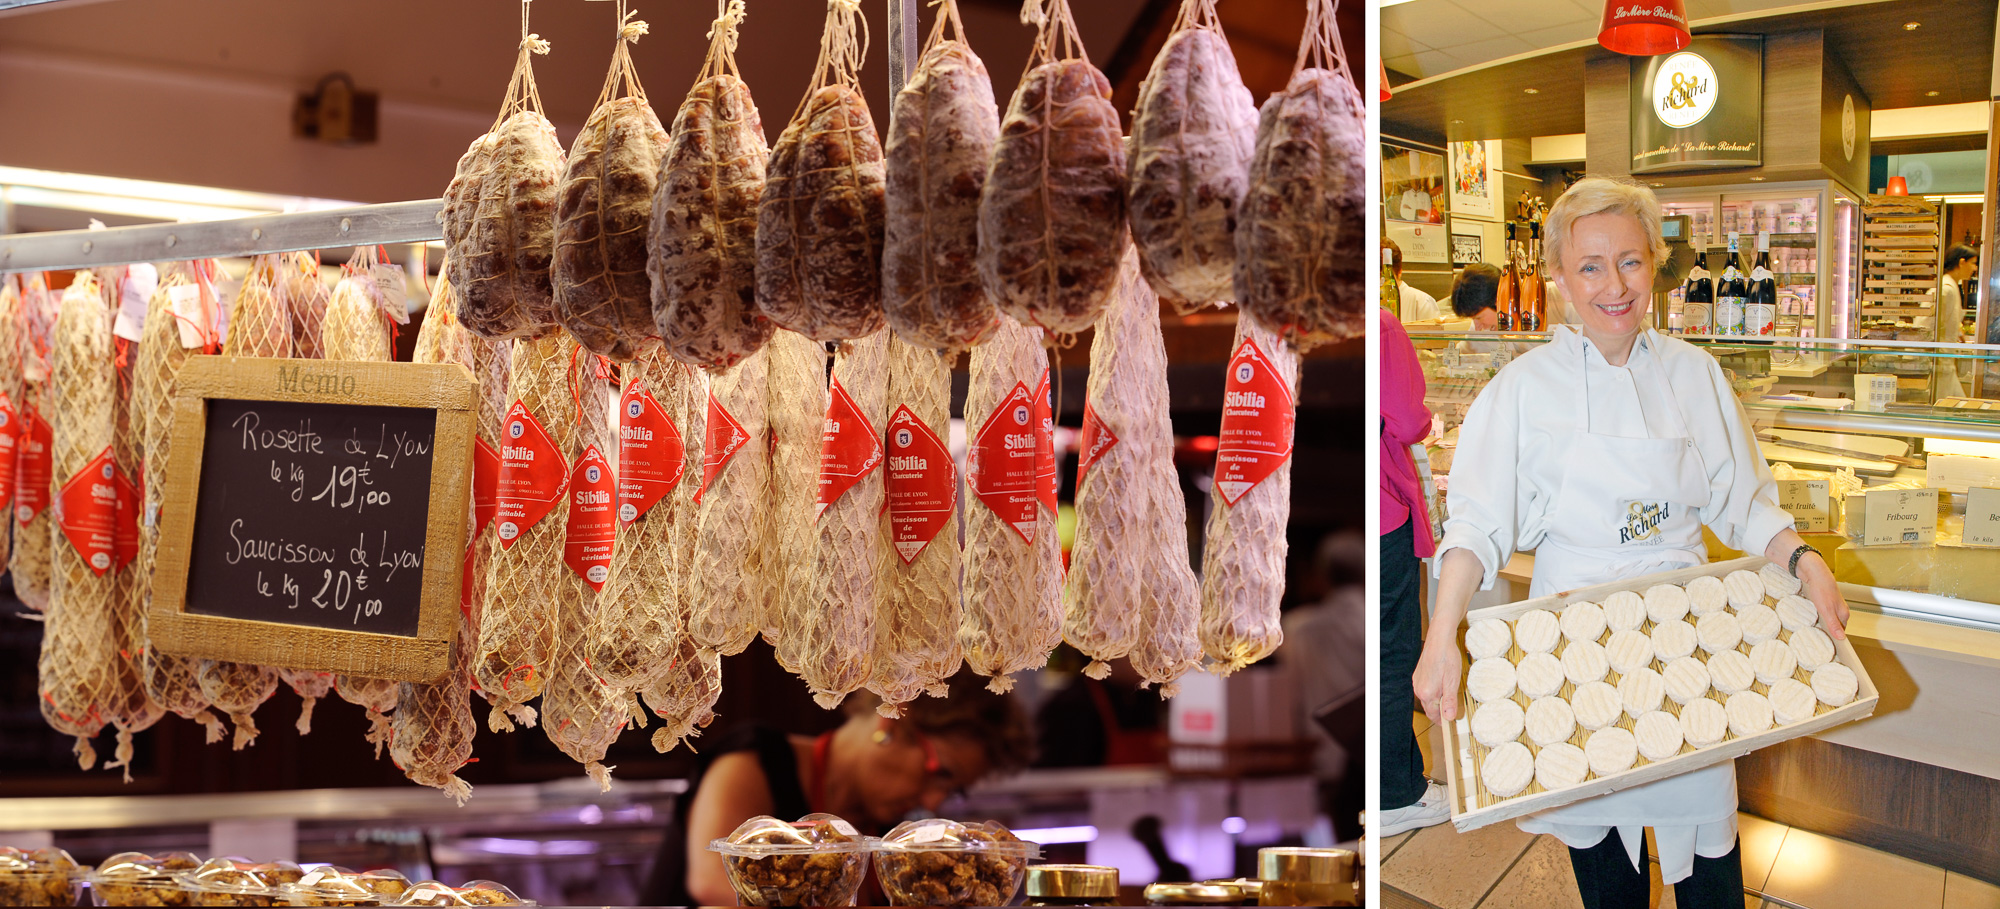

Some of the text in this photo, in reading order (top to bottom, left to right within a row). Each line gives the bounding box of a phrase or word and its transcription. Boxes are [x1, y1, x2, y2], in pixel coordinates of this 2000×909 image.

[1614, 4, 1684, 24] La Mère Richard
[1662, 78, 1708, 111] Richard
[1225, 391, 1265, 409] Sibilia
[1226, 408, 1259, 417] Charcuterie
[232, 411, 323, 454] Rosette
[344, 427, 366, 455] de
[620, 425, 653, 441] Sibilia
[502, 445, 534, 461] Sibilia
[1219, 454, 1258, 463] Saucisson
[889, 455, 927, 471] Sibilia
[1230, 463, 1241, 471] de
[1225, 472, 1244, 481] Lyon
[500, 501, 524, 509] Rosette
[576, 490, 610, 505] Sibilia
[1619, 501, 1669, 545] Richard
[1886, 512, 1918, 522] Fribourg
[1989, 513, 2000, 522] Be
[226, 518, 335, 564] Saucisson
[350, 532, 369, 567] de
[900, 533, 917, 542] Lyon
[583, 545, 609, 553] Rosette
